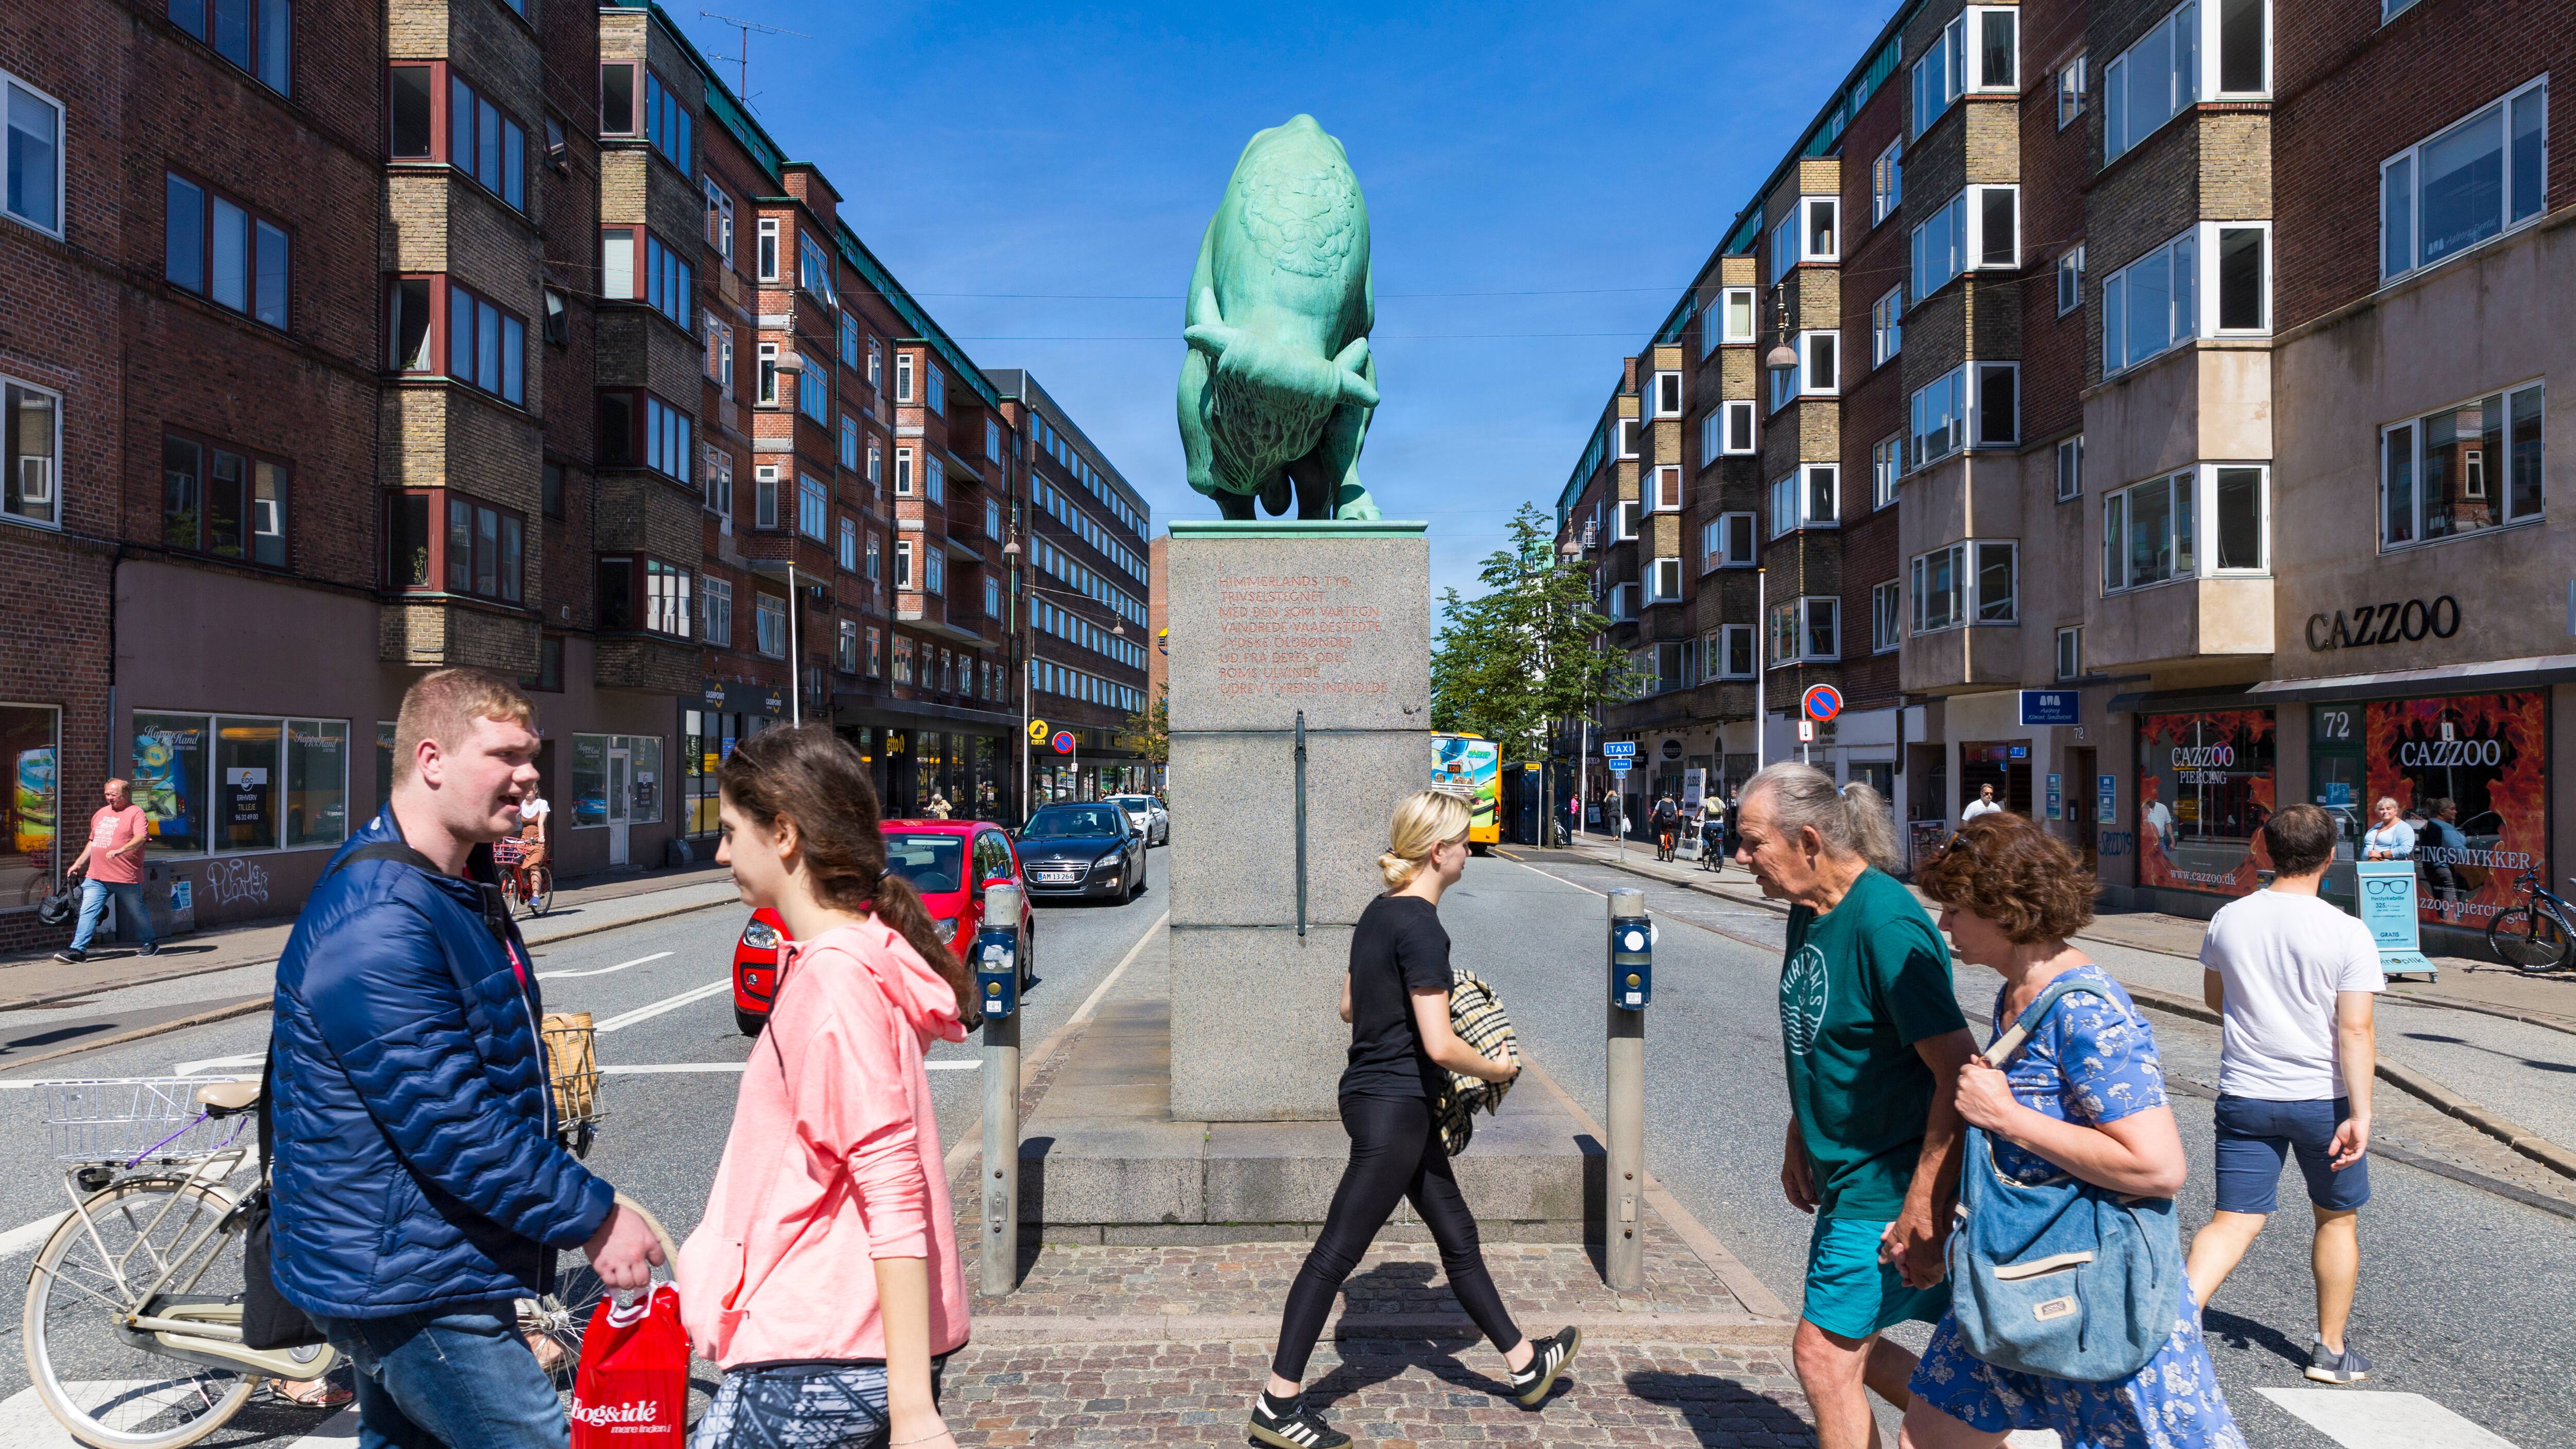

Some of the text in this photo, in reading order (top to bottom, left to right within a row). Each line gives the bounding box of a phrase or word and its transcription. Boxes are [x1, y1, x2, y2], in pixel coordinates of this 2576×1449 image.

[1219, 576, 1318, 587] HIMMERLANDS
[1219, 606, 1380, 618] MED DEN SOM VARTEGN
[1221, 622, 1381, 633] VANDREDE VAADESTEDTE
[2306, 595, 2461, 652] CAZZOO
[1220, 637, 1352, 648] JYDSKE OLDBØNDER
[1219, 652, 1347, 663] UD FRA DERES ODEL
[1219, 668, 1320, 678] ROMS ULVINDE
[706, 690, 724, 700] CASHPOINT
[1219, 683, 1387, 694] UDREV TYRENS INDVOLDE
[766, 698, 782, 706] CASHPOINT
[2324, 711, 2349, 737] 72
[143, 725, 200, 744] Happy Hand
[294, 731, 338, 747] Happy Hand
[377, 733, 396, 748] Happ
[2074, 727, 2083, 740] 72
[887, 736, 899, 753] etto
[2172, 746, 2234, 767] CAZZOO
[2401, 739, 2501, 766] CAZZOO
[2179, 770, 2227, 785] PIERCING
[2413, 846, 2531, 870] CINGSMYKKER
[2171, 870, 2236, 885] www.cazzoo.dk
[571, 1397, 657, 1427] Bog&idé
[611, 1425, 638, 1433] mere
